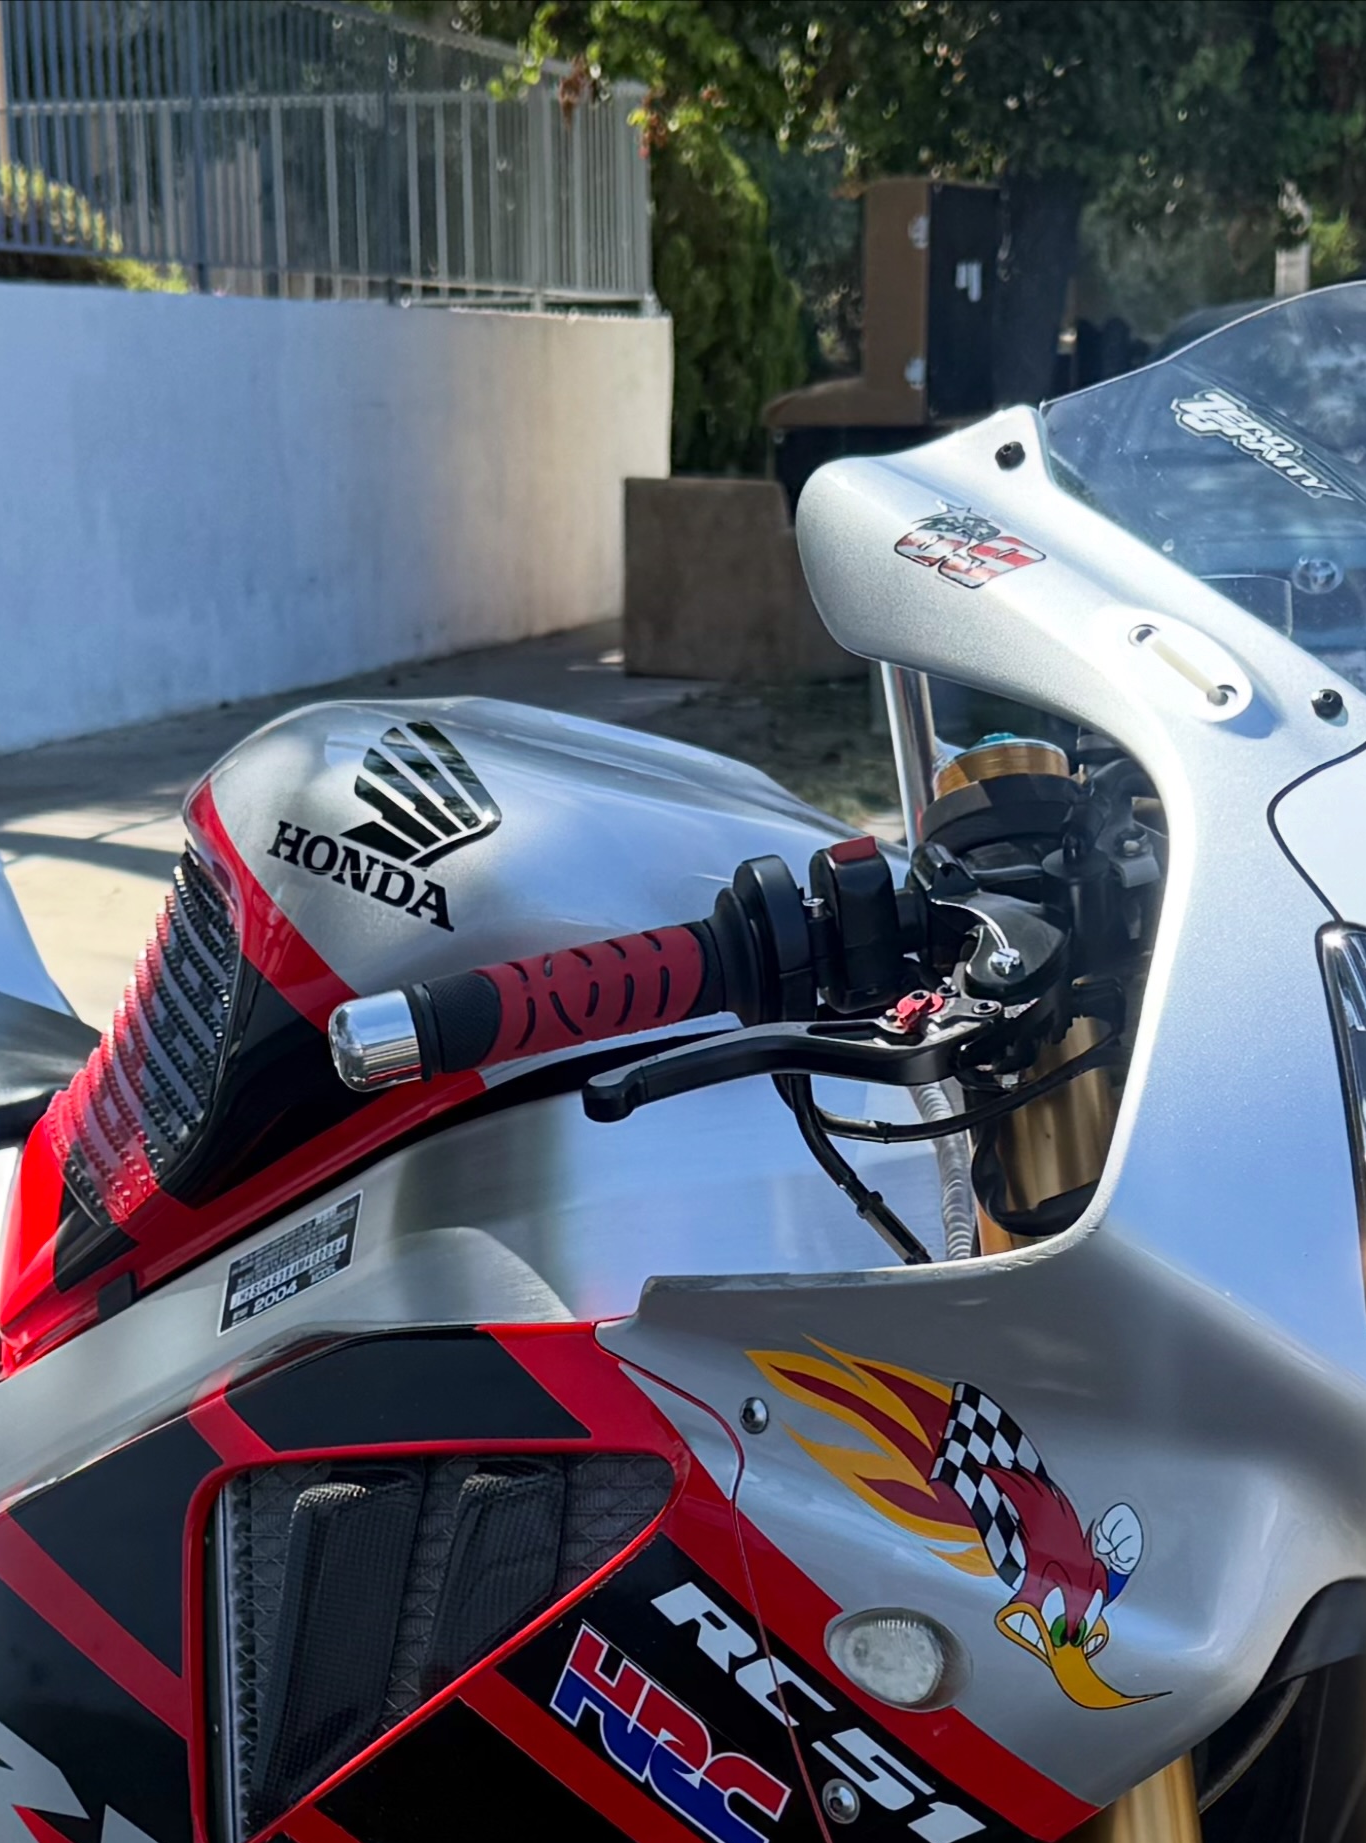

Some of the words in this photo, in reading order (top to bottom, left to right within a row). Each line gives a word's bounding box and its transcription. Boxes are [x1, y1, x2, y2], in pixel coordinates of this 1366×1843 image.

[1179, 391, 1295, 453] ZERO
[1180, 411, 1329, 488] GRAVITY
[267, 820, 455, 933] HONDA
[252, 1279, 298, 1314] 2004
